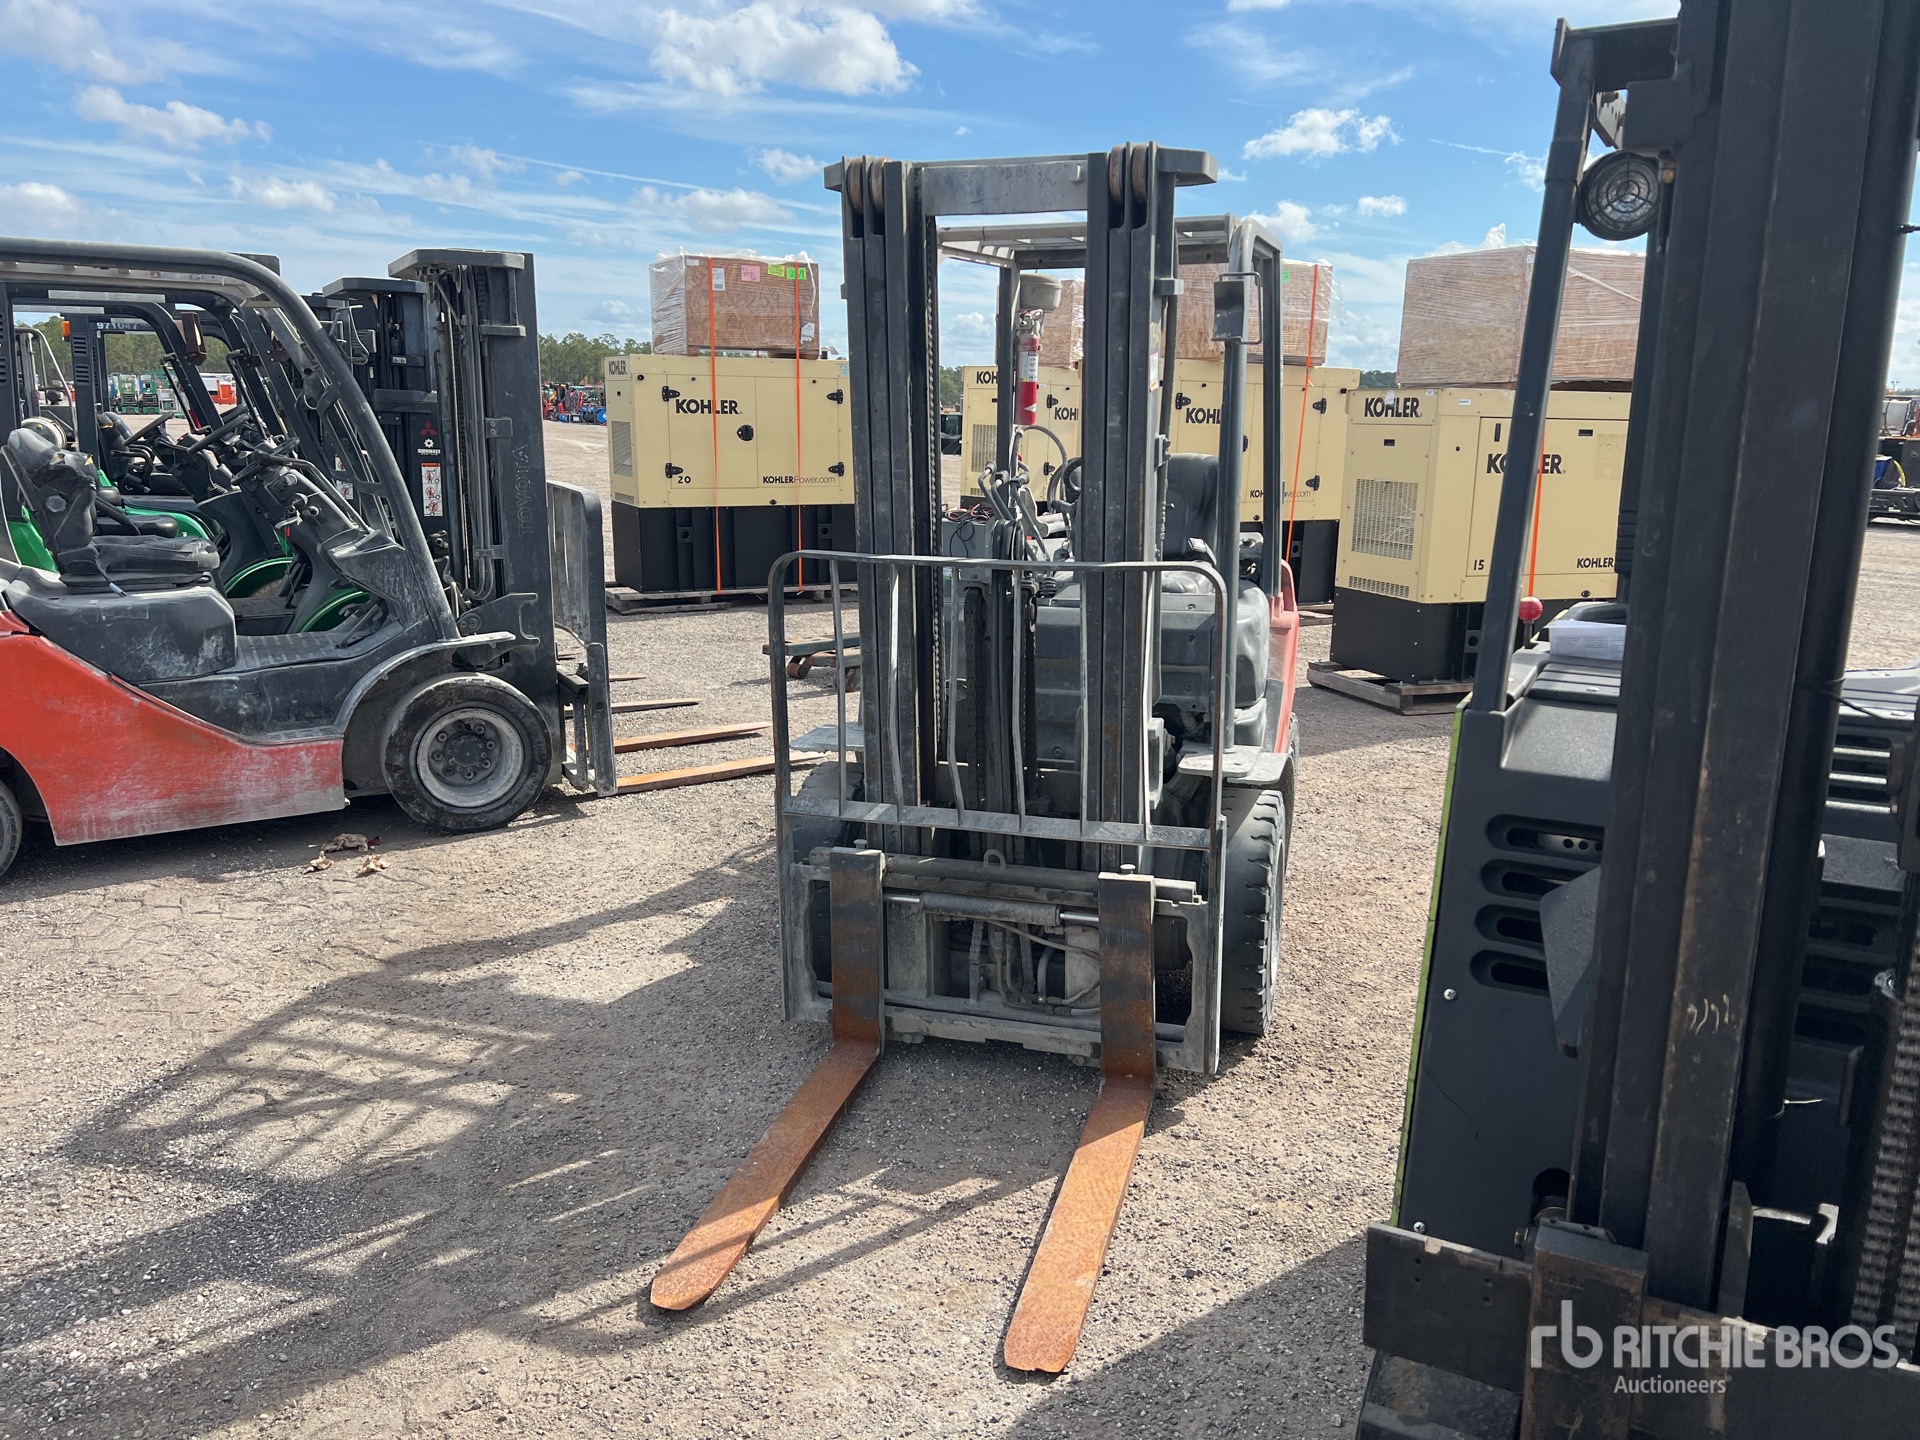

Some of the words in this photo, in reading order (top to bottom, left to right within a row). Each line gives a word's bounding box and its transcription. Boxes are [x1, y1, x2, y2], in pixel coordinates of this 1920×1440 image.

[608, 359, 627, 375] KOHLER
[976, 371, 998, 384] KOH
[1054, 407, 1079, 421] KOH
[1364, 397, 1420, 418] KOHLER
[1185, 407, 1221, 425] KOHL
[677, 475, 692, 484] 20
[762, 475, 836, 485] KOHLERPower.com
[512, 444, 535, 538] TOYOTA
[1473, 559, 1485, 571] 15
